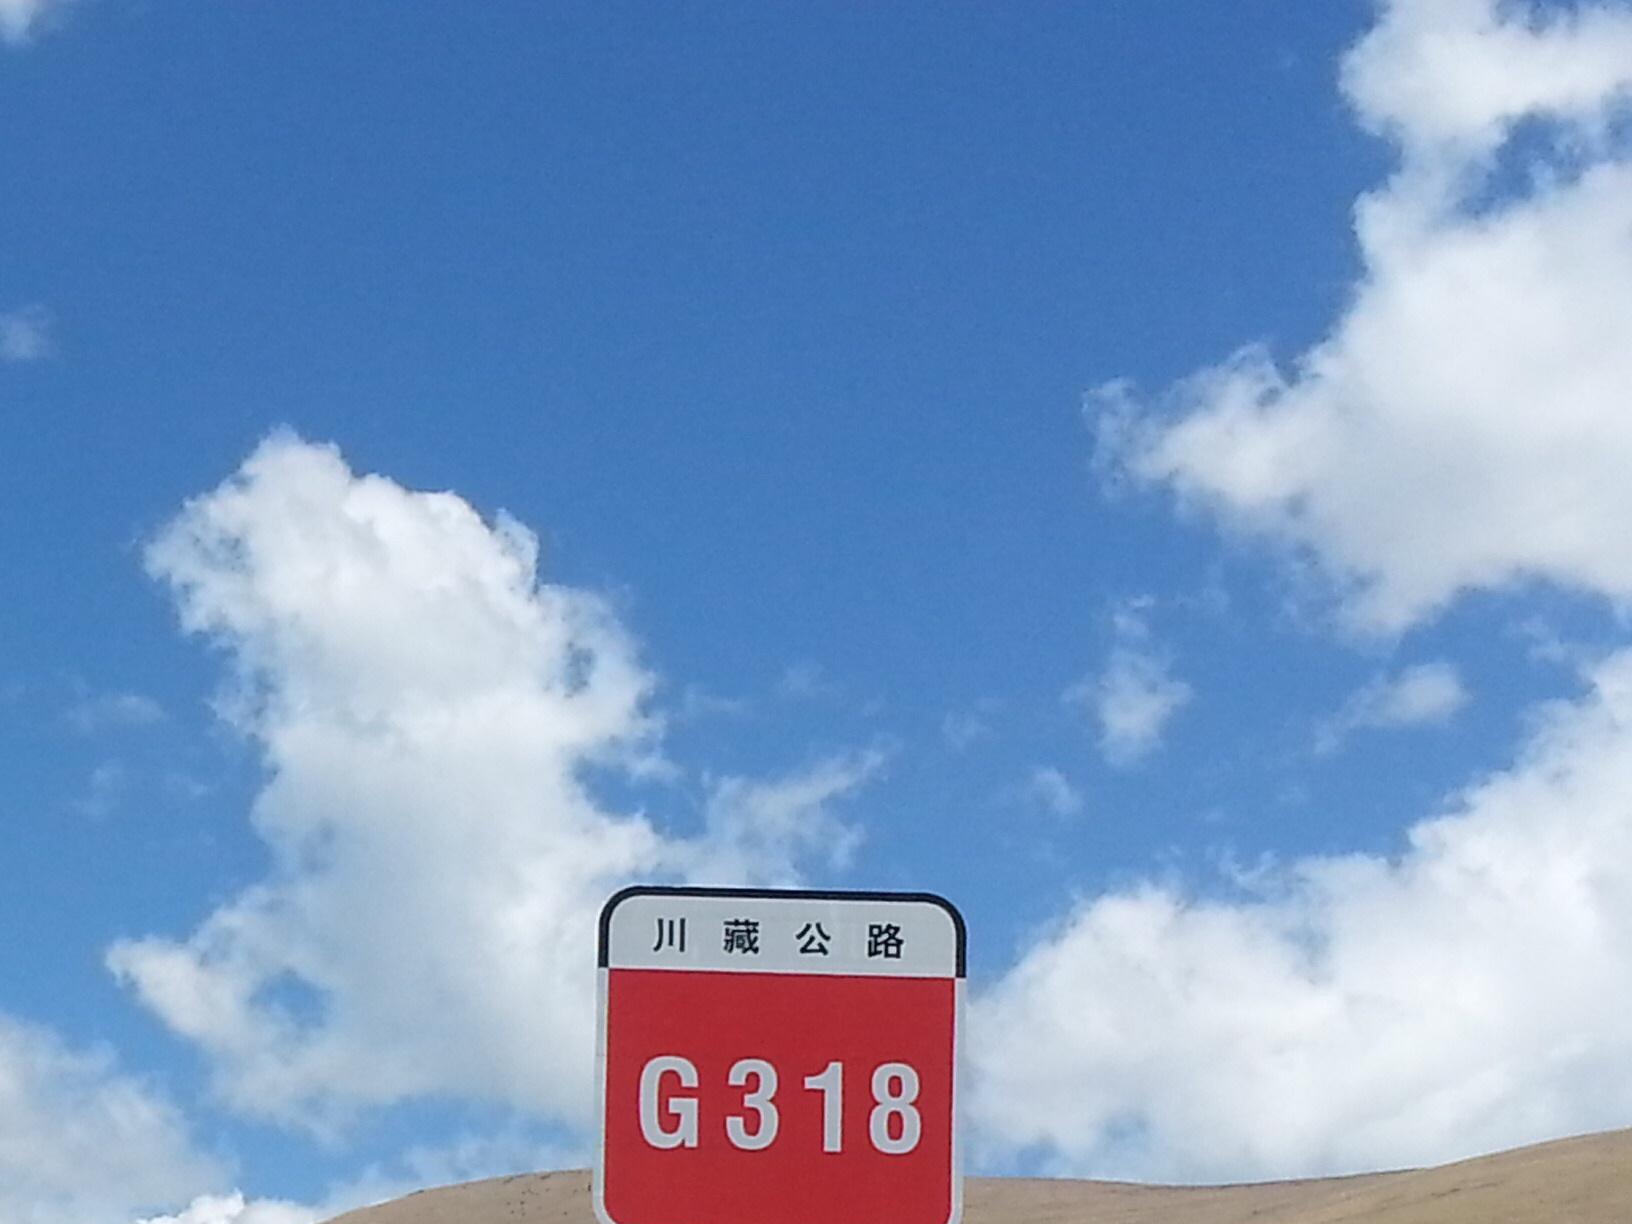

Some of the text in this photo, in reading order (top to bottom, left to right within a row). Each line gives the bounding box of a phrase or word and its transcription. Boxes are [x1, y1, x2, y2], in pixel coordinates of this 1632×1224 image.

[652, 917, 905, 959] 川藏公路
[638, 1055, 922, 1155] G318
